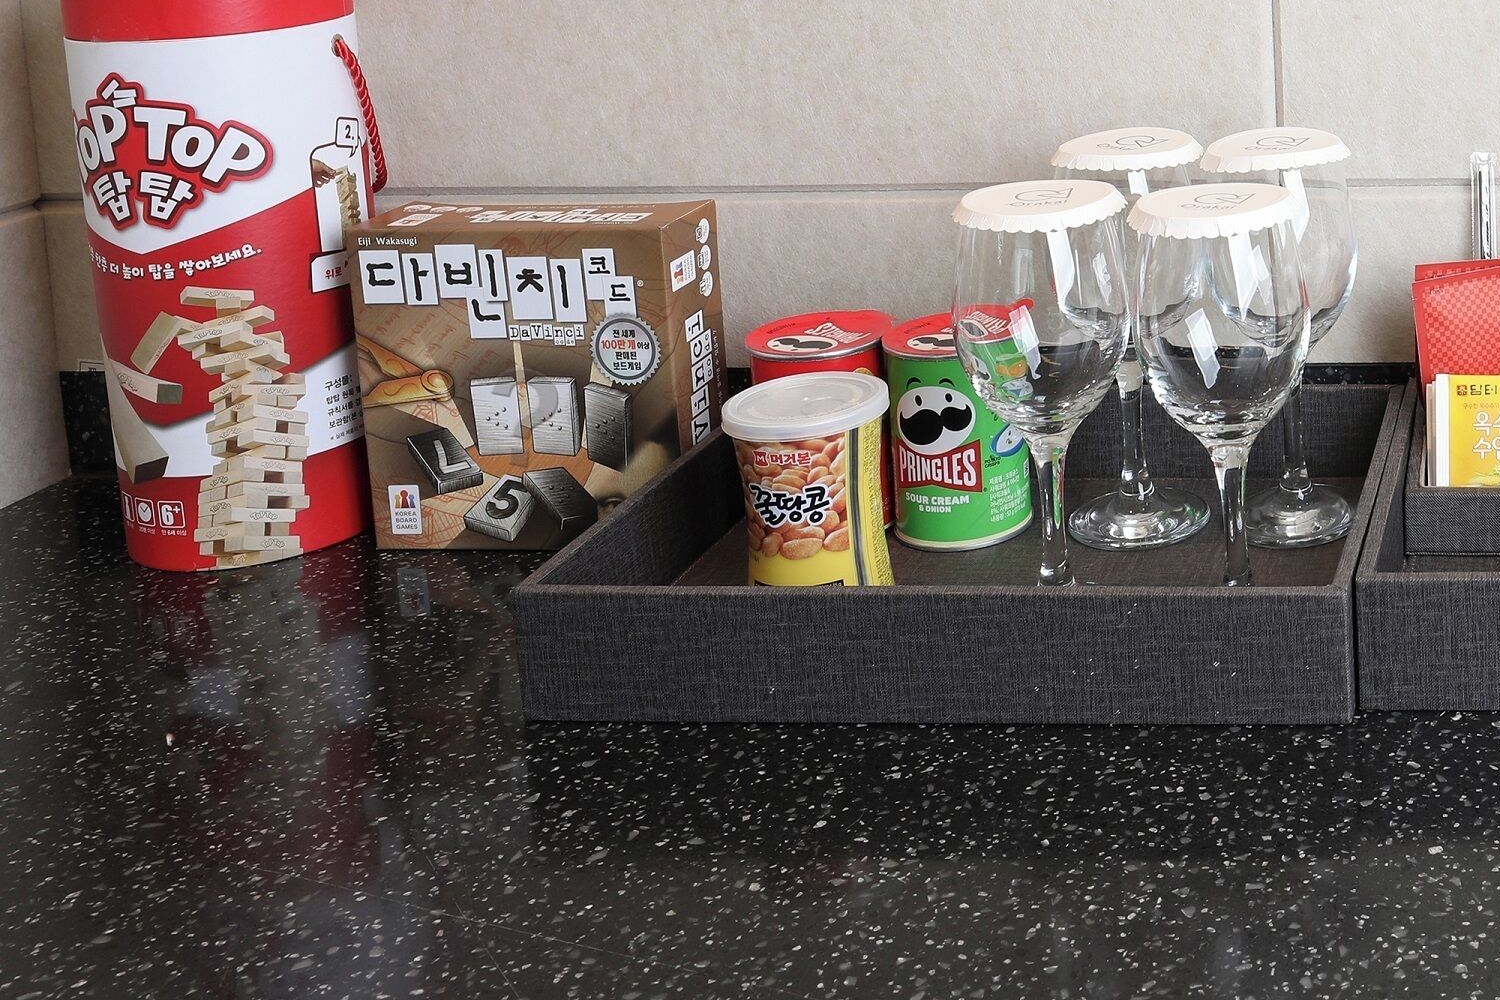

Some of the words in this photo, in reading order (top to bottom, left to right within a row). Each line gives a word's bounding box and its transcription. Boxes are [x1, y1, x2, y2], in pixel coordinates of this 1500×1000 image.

[74, 105, 127, 184] OP
[133, 105, 266, 183] TOP
[357, 236, 371, 248] Eiji
[375, 235, 417, 248] Wakasugi
[110, 263, 119, 274] 더
[122, 263, 144, 281] 높이
[148, 262, 175, 281] 탑을
[179, 243, 262, 277] 쌓아보세요.
[510, 324, 584, 339] DaVinci
[620, 329, 636, 338] 세계
[601, 339, 626, 350] 100만
[627, 339, 636, 350] 개
[637, 341, 650, 350] 이상
[615, 351, 637, 361] 판매된
[613, 361, 642, 371] 보드게임
[770, 451, 811, 465] 머거본
[899, 444, 977, 487] PRINGLES
[485, 479, 528, 519] 5
[749, 484, 830, 526] 꿀땅콩
[905, 492, 929, 505] SOUR
[931, 495, 970, 506] CREAM
[925, 505, 952, 513] ONION
